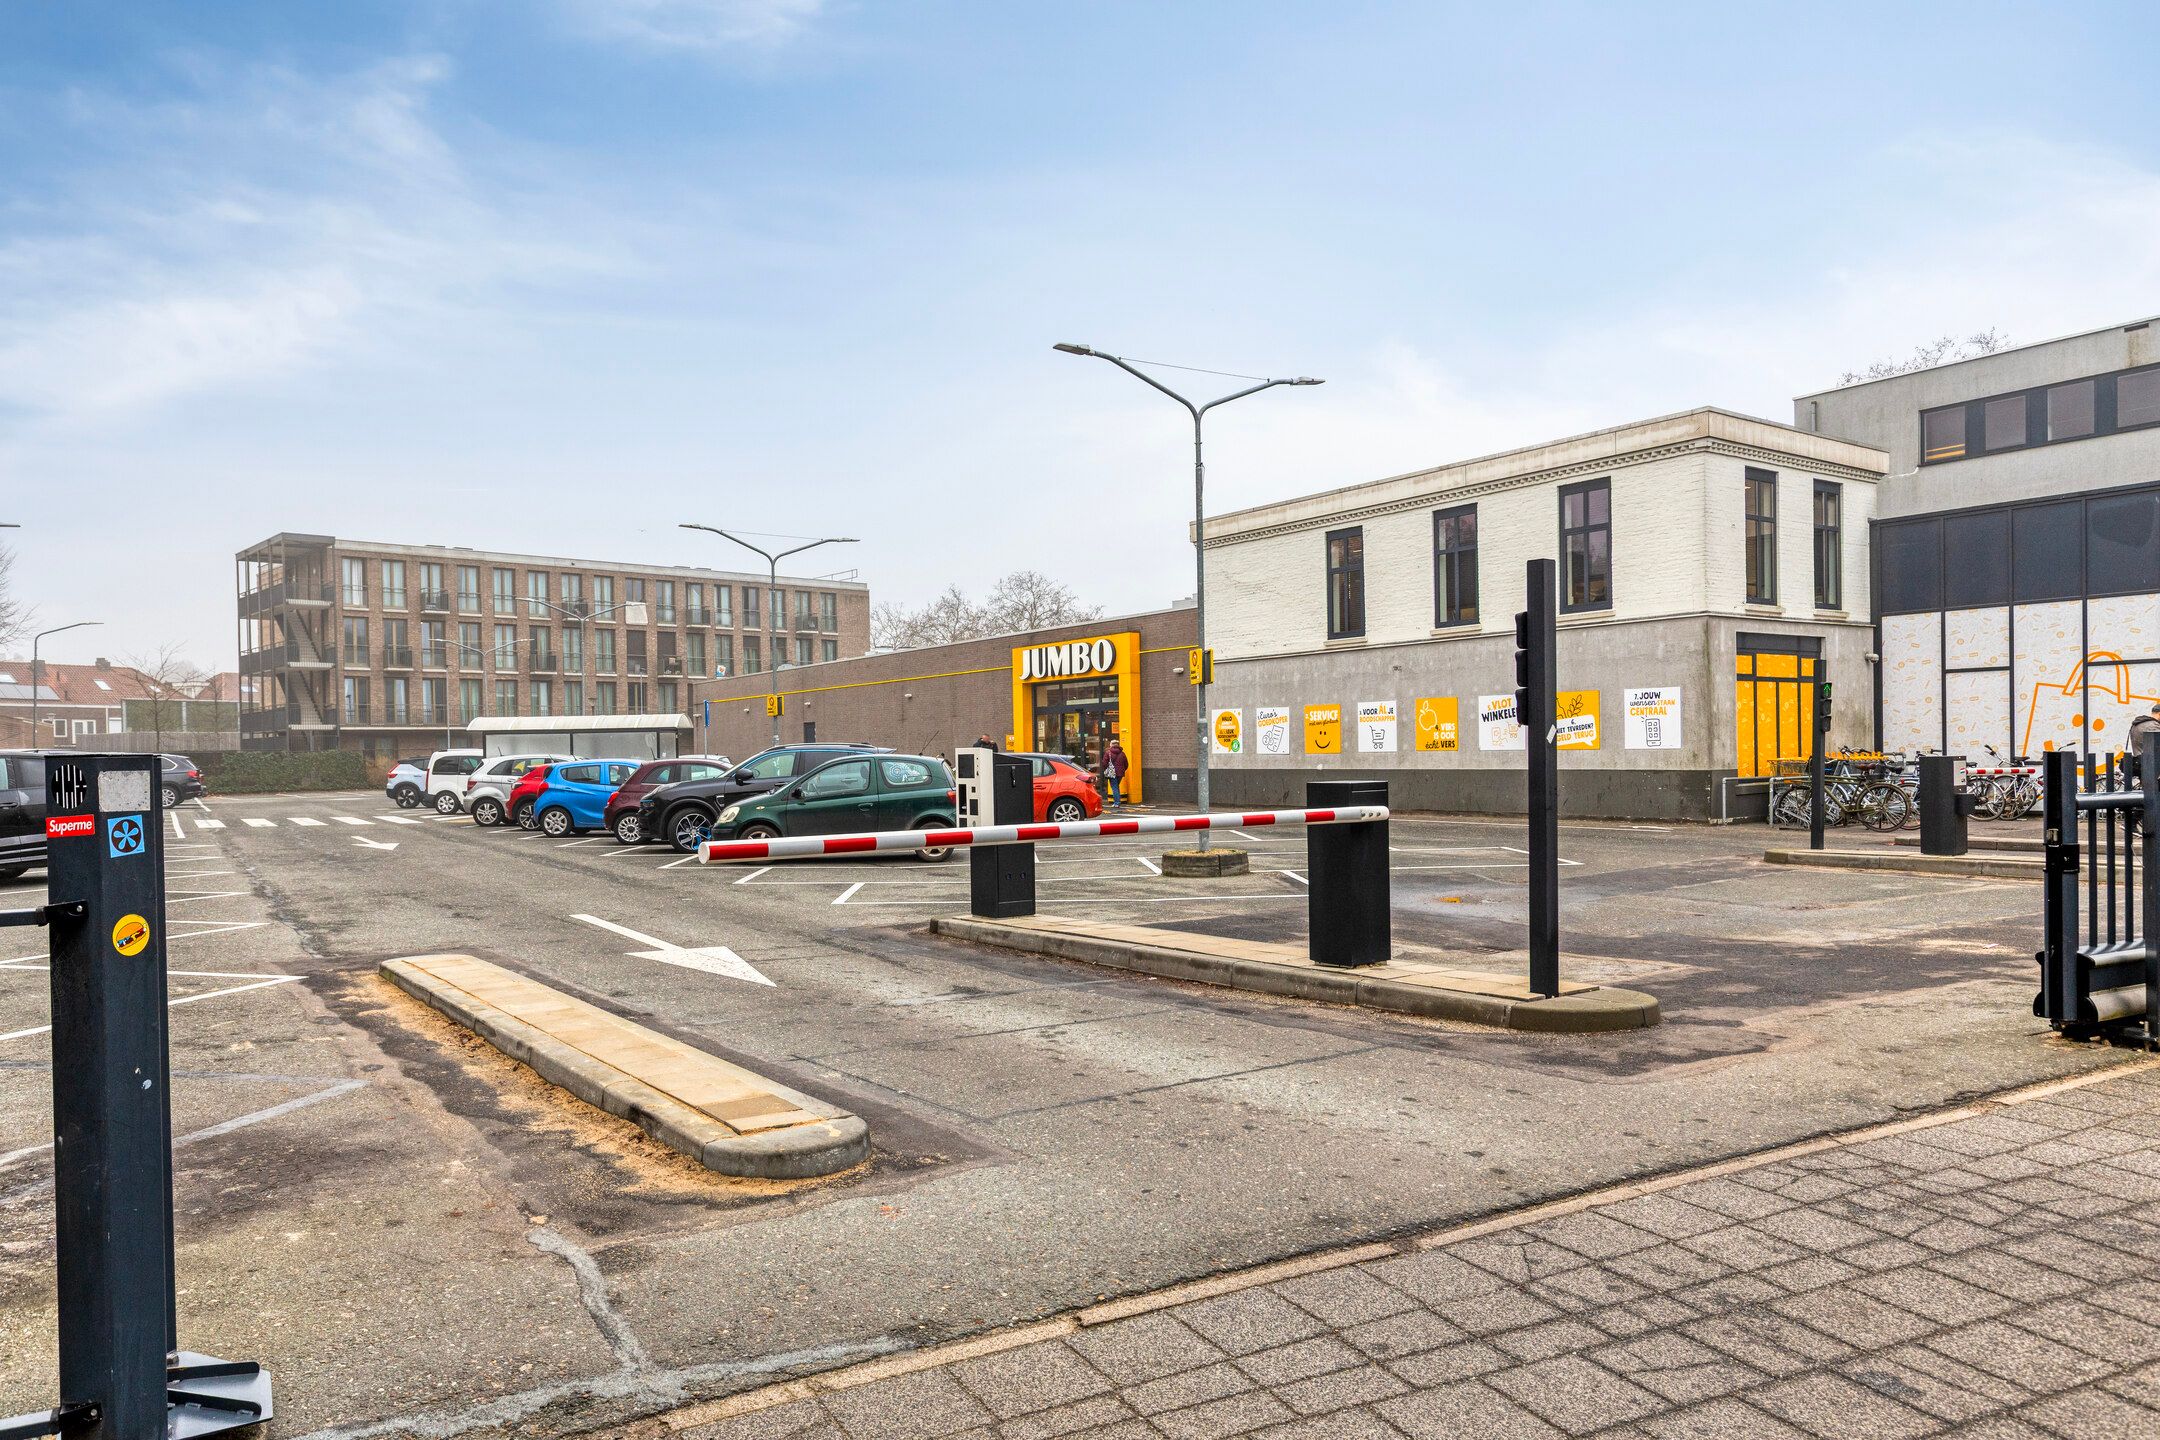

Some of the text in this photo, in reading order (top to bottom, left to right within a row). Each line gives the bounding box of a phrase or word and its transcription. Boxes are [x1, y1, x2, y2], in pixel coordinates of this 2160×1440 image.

[1020, 639, 1114, 680] JUMBO
[1640, 691, 1661, 700] JOUW
[1492, 697, 1512, 710] VLOT
[1260, 709, 1277, 719] Euro's
[1310, 710, 1339, 721] SERVICE
[1481, 707, 1517, 723] WINKELE
[1630, 706, 1667, 716] CENTRAAL
[1441, 723, 1456, 731] VERS
[1567, 722, 1594, 733] TEVREDEN?
[1441, 732, 1456, 740] OOK
[1557, 730, 1594, 742] GELD TERUG
[1440, 740, 1456, 748] VERS
[49, 819, 93, 835] Superme
